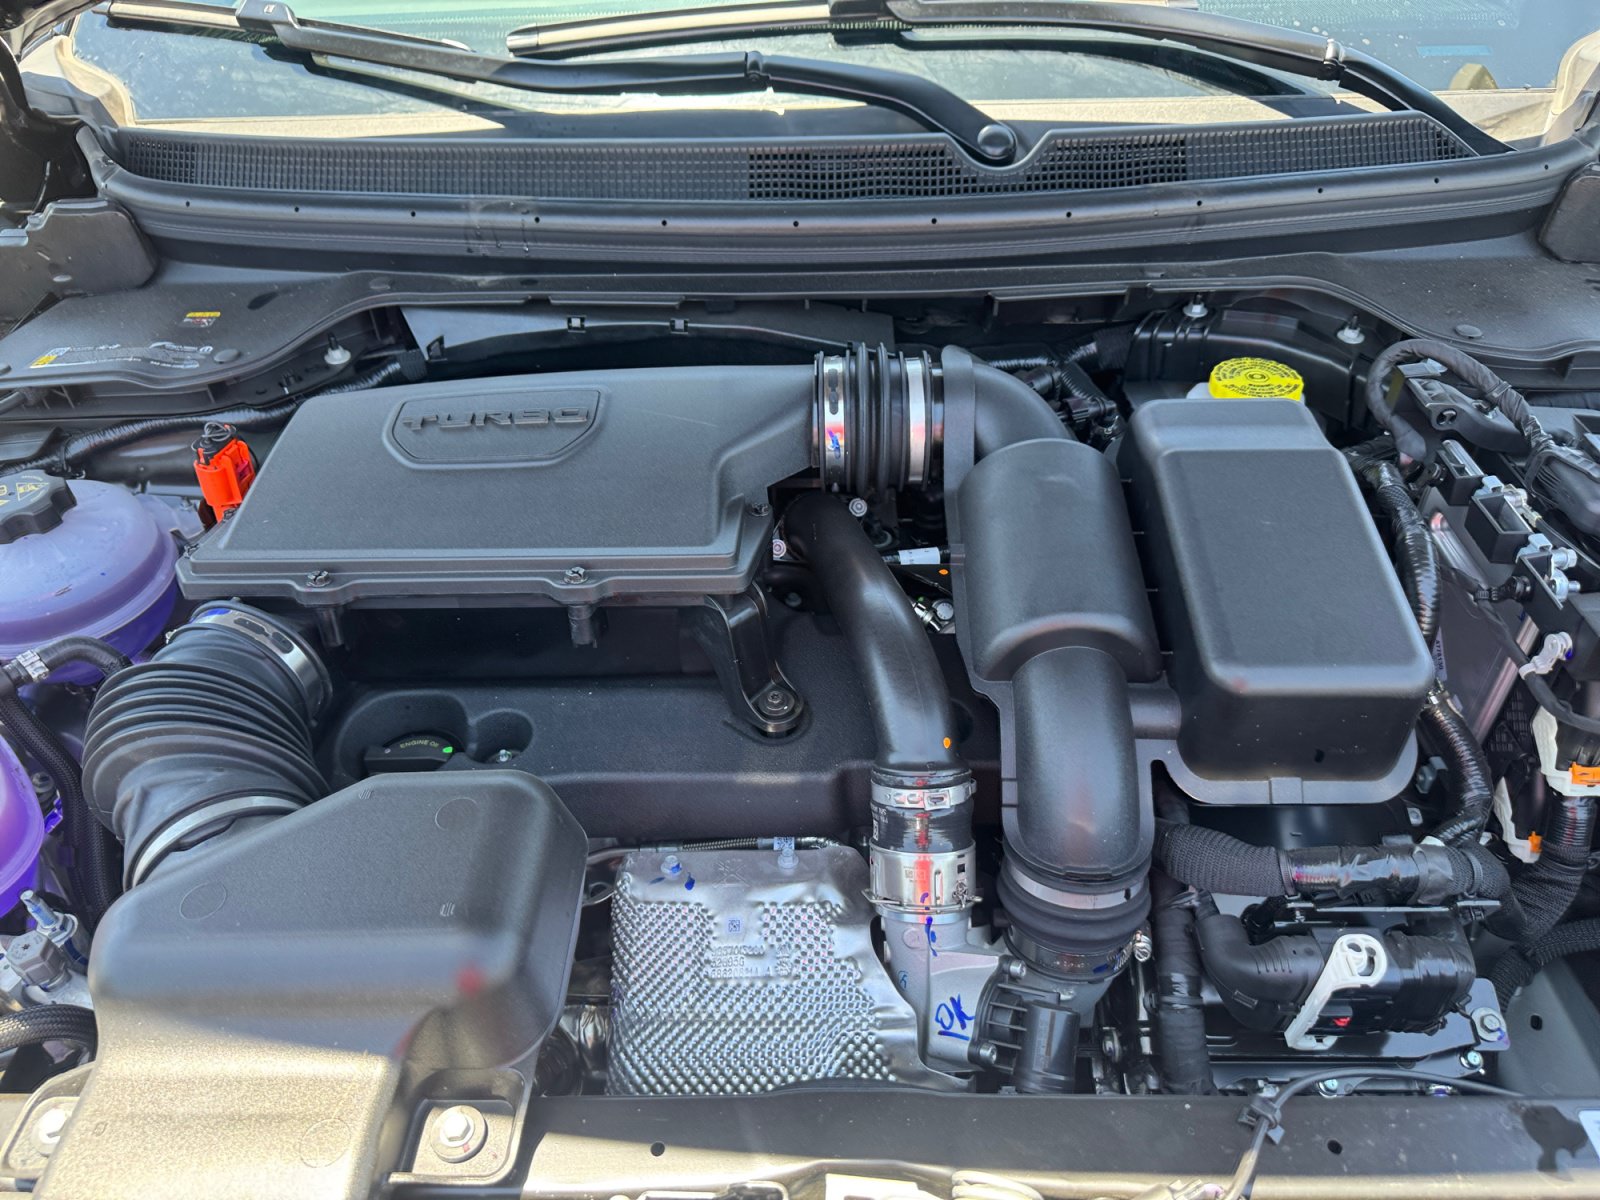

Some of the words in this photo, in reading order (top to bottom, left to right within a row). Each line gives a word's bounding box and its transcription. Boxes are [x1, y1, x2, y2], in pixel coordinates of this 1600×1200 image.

[402, 408, 589, 431] TURBO
[400, 739, 429, 748] ENGINE
[935, 993, 976, 1031] OK
